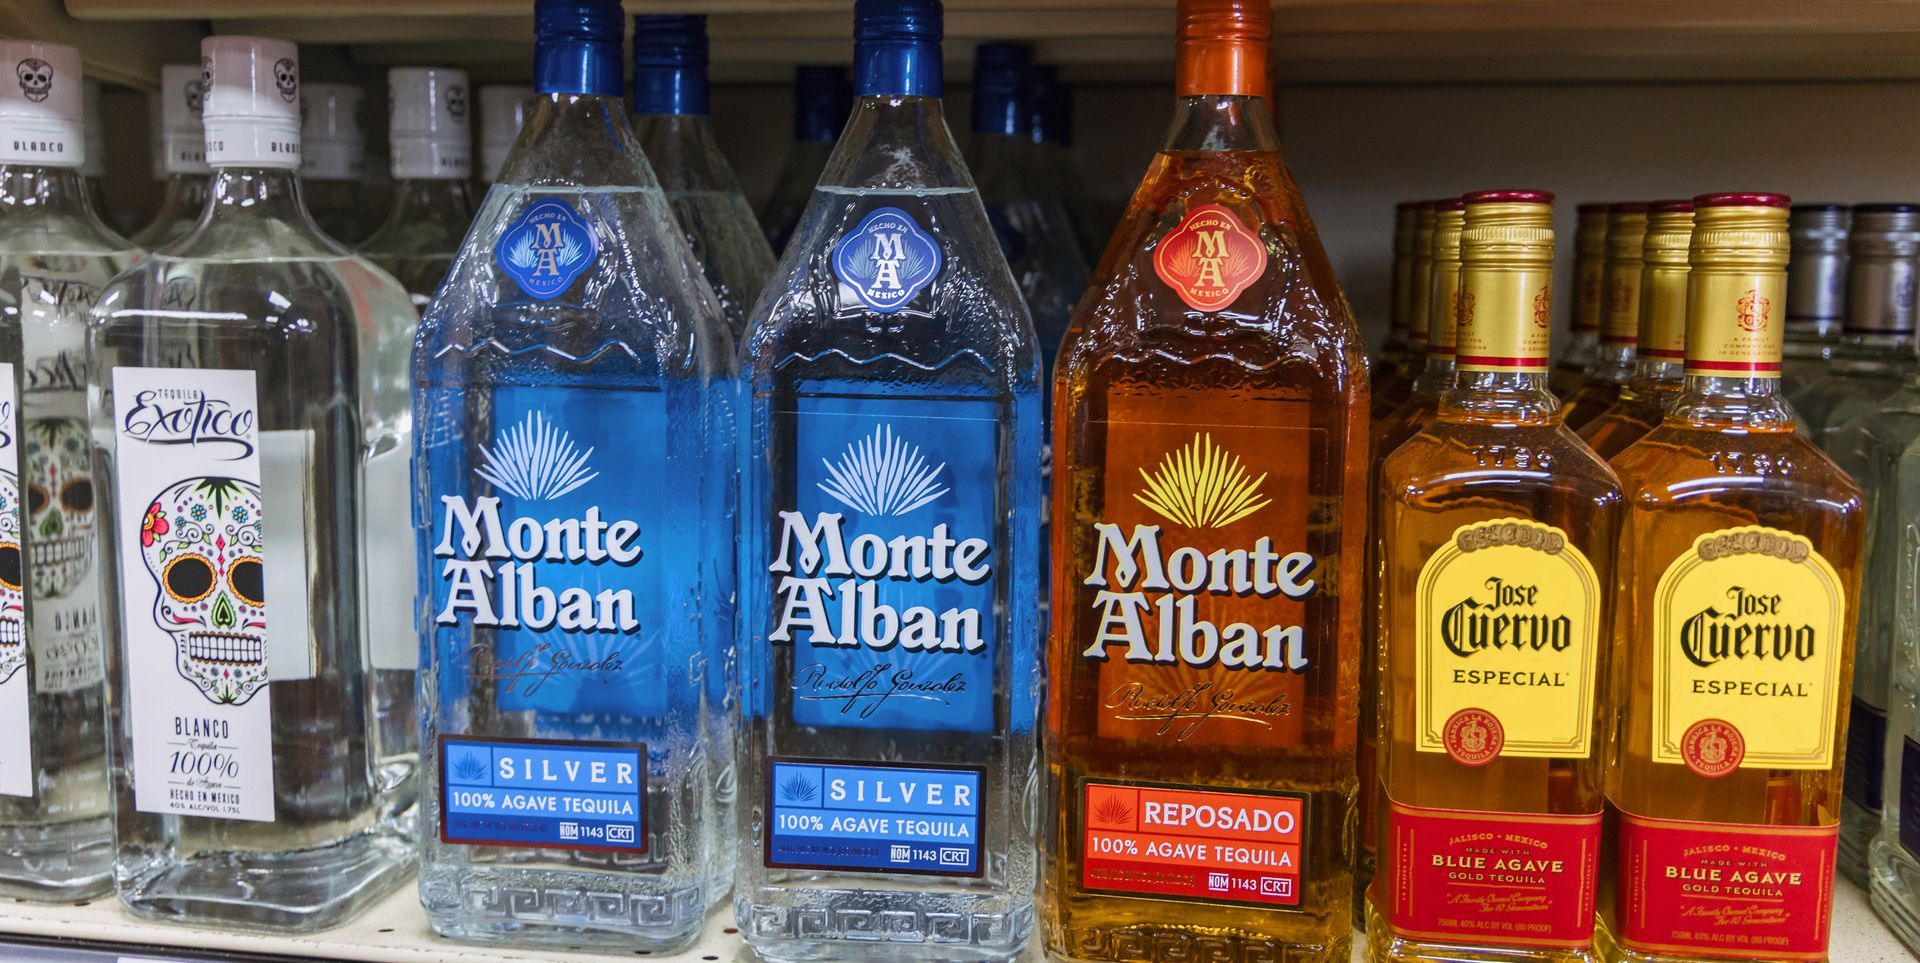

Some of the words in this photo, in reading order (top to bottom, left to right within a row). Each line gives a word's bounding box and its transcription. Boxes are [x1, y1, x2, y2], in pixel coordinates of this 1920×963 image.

[531, 222, 565, 249] M
[868, 222, 896, 234] HECHO
[896, 224, 909, 234] EN
[1189, 219, 1218, 232] HECHO
[1220, 221, 1232, 231] EN
[870, 233, 906, 260] M
[1192, 230, 1230, 258] M
[532, 248, 560, 276] A
[871, 259, 902, 289] A
[1193, 257, 1226, 287] A
[866, 288, 905, 299] MEXICO
[1189, 287, 1229, 298] MEXICO
[158, 388, 198, 400] TEQUILA
[122, 390, 254, 455] Exotico
[434, 495, 643, 566] Monte
[768, 510, 993, 584] Monte
[1083, 522, 1317, 598] Monte
[436, 558, 641, 634] Alban
[1484, 576, 1539, 610] Jose
[1726, 586, 1782, 620] Jose
[768, 576, 986, 655] Alban
[1441, 597, 1571, 658] Cuervo
[1083, 590, 1310, 674] Alban
[1680, 606, 1815, 668] Cuervo
[1452, 669, 1565, 687] ESPECIAL
[1692, 680, 1809, 697] ESPECIAL
[175, 716, 229, 739] BLANCO
[169, 751, 239, 778] 100%
[1456, 747, 1491, 760] TEQUILA
[1695, 758, 1730, 771] TEQUILA
[499, 757, 633, 785] SILVER
[170, 789, 194, 801] HECHO
[198, 790, 207, 802] EN
[211, 793, 240, 805] MEXICO
[453, 791, 495, 809] 100%
[501, 794, 557, 812] AGAVE
[563, 797, 633, 816] TEQUILA
[830, 778, 971, 807] SILVER
[189, 803, 221, 812] ALC/VOL
[1144, 802, 1295, 834] REPOSADO
[580, 826, 604, 839] 1143
[608, 826, 632, 840] CRT
[779, 814, 824, 831] 100%
[830, 817, 889, 834] AGAVE
[896, 819, 970, 838] TEQUILA
[1092, 837, 1138, 855] 100%
[1145, 841, 1207, 861] AGAVE
[1214, 846, 1292, 867] TEQUILA
[1449, 832, 1494, 847] JALISCO
[1505, 833, 1548, 849] MEXICO
[1683, 844, 1730, 859] JALISCO
[1742, 846, 1786, 861] MEXICO
[890, 846, 910, 861] NOM
[912, 849, 937, 861] 1143
[941, 850, 967, 864] CRT
[1432, 854, 1486, 869] BLUE
[1494, 859, 1564, 874] AGAVE
[1208, 873, 1229, 890] NOM
[1231, 877, 1257, 890] 1143
[1262, 878, 1290, 893] CRT
[1448, 872, 1484, 881] GOLD
[1489, 874, 1546, 884] TEQUILA
[1665, 866, 1722, 881] BLUE
[1730, 870, 1802, 885] AGAVE
[1682, 884, 1720, 893] GOLD
[1724, 886, 1783, 896] TEQUILA
[1476, 921, 1490, 930] ALC
